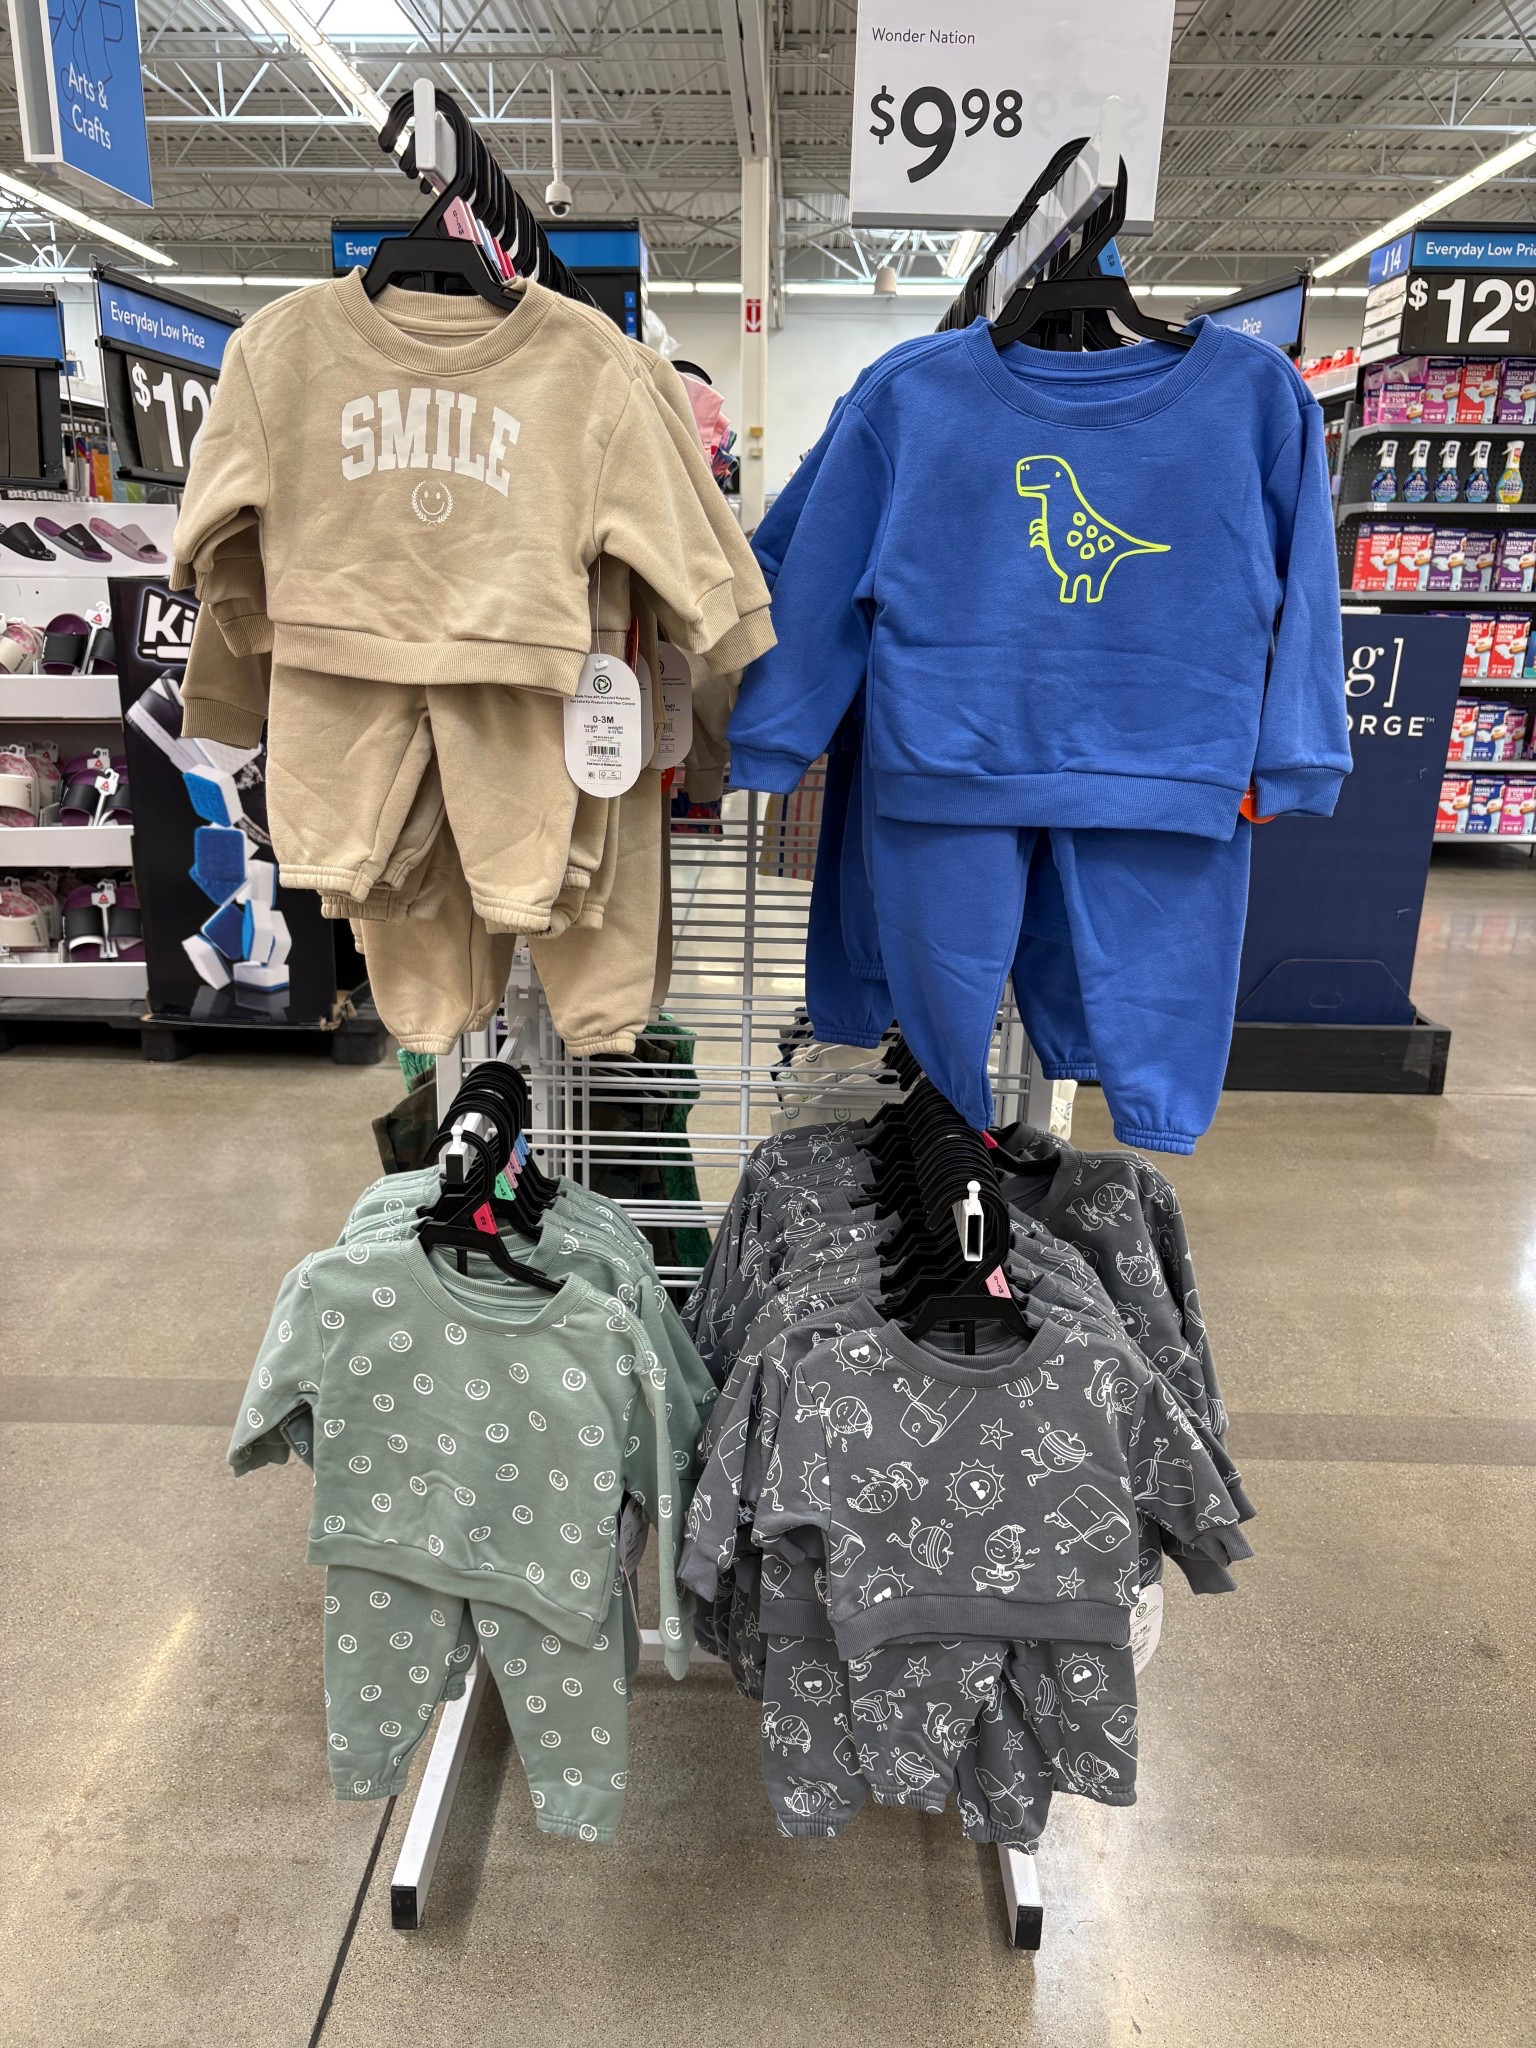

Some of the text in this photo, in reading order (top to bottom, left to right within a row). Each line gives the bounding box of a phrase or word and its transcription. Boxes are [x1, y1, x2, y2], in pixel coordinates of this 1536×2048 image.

[872, 27, 975, 44] Wonder Nation
[68, 61, 108, 111] Arts &
[72, 104, 111, 150] Crafts
[1426, 242, 1485, 259] Everyday
[1487, 243, 1513, 256] Low
[110, 300, 205, 349] Everyday Low Price
[341, 388, 521, 497] SMILE
[592, 715, 614, 724] 0-3M
